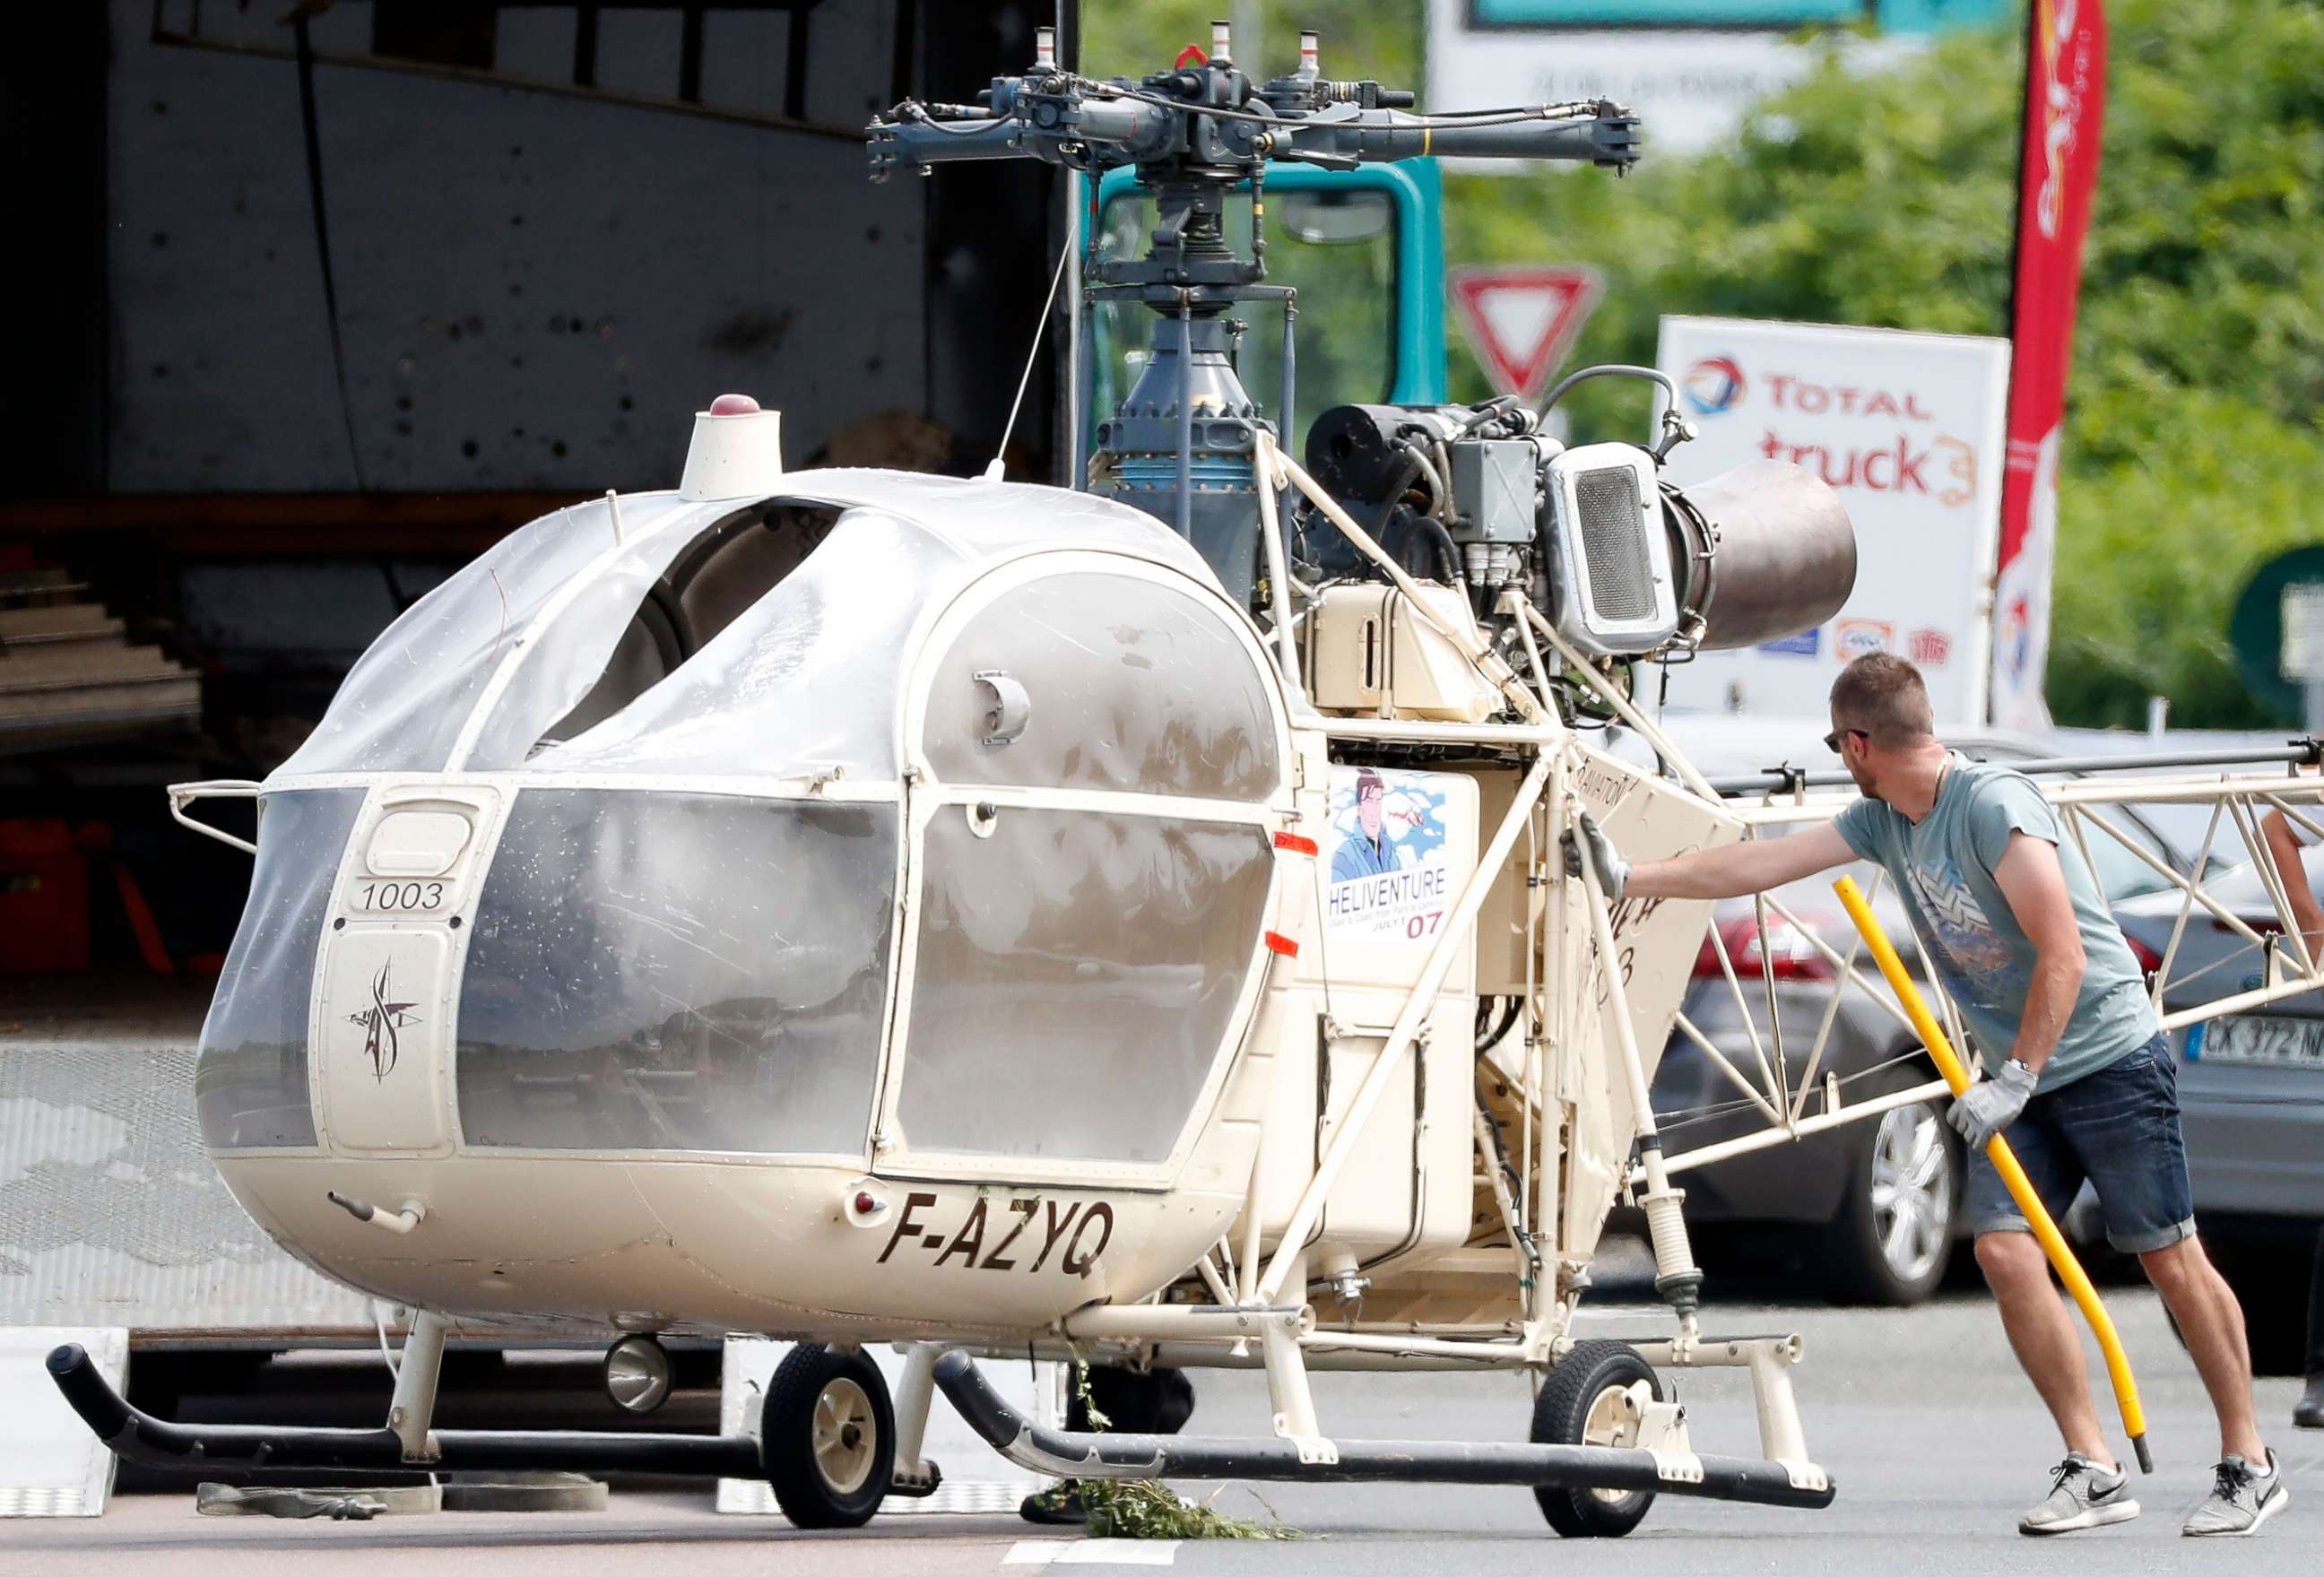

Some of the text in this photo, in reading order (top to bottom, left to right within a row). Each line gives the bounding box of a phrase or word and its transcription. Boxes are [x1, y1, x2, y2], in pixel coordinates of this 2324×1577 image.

[362, 882, 444, 910] 1003
[1329, 867, 1445, 916] HELIVENTURE
[1372, 919, 1398, 932] JULY
[1407, 910, 1444, 940] 07
[876, 1191, 1114, 1280] F-AZYQ
